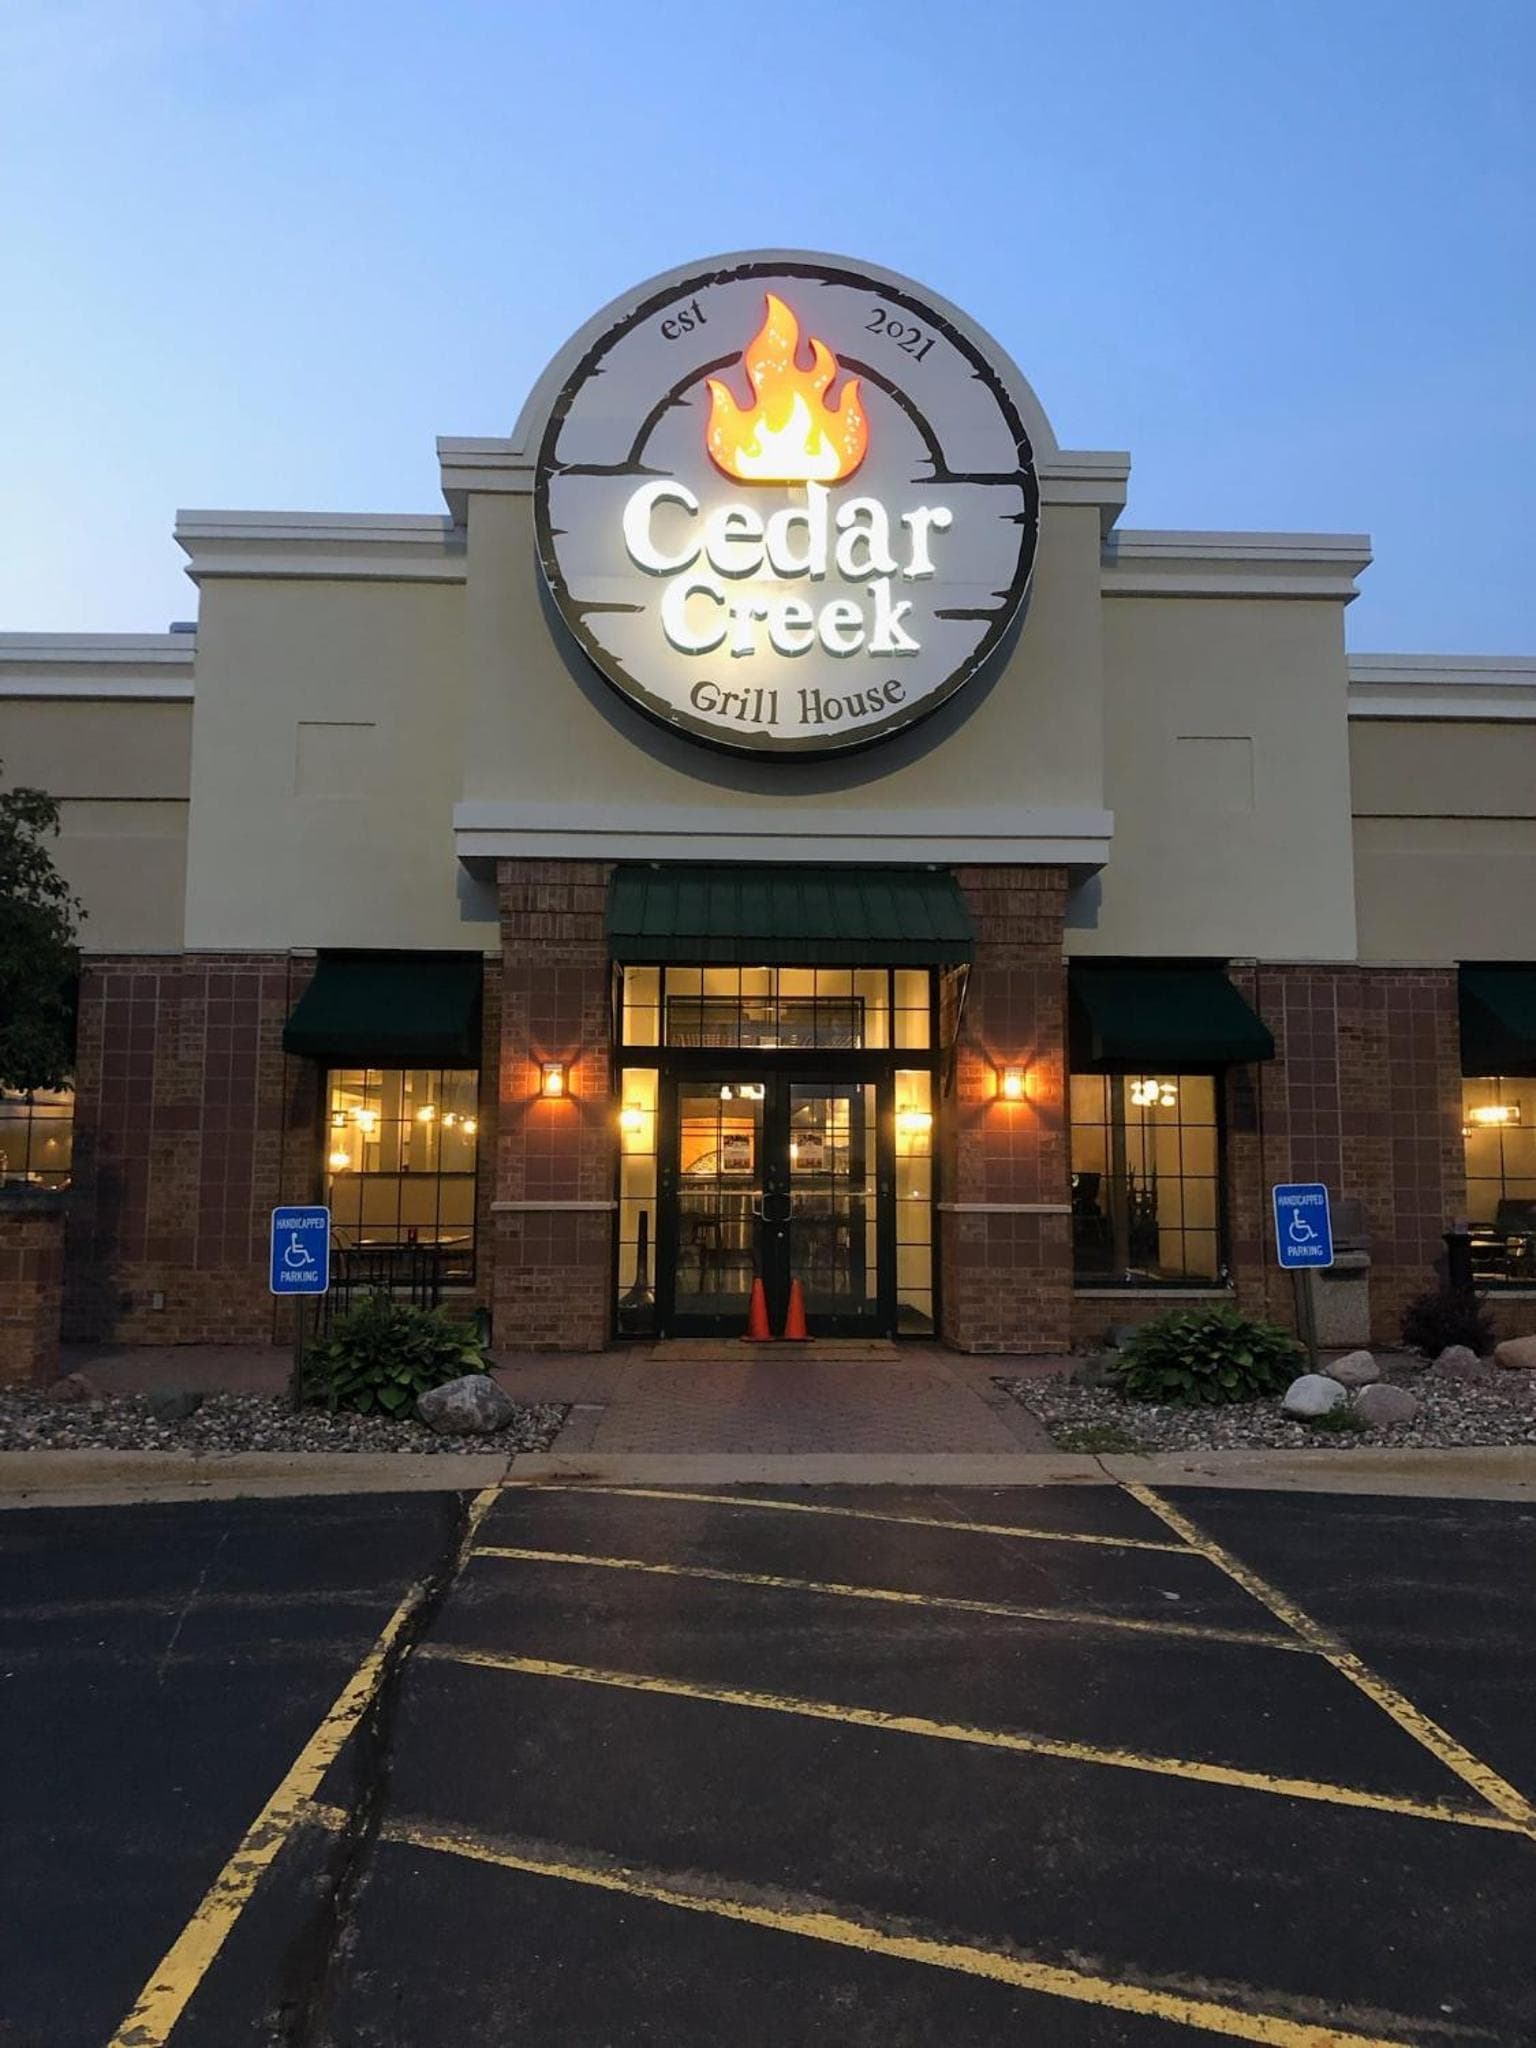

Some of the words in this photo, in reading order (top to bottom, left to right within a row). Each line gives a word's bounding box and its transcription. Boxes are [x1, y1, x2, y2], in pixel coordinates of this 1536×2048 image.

[660, 298, 707, 341] est
[865, 308, 937, 362] 2021
[622, 480, 953, 580] Cedar
[660, 574, 920, 657] Creek
[689, 680, 778, 724] Grill
[799, 679, 906, 724] House
[1278, 1195, 1324, 1206] HANDICAPPED
[276, 1218, 325, 1229] HANDICAPPED
[1288, 1245, 1323, 1256] PARKING
[281, 1271, 318, 1281] PARKING
